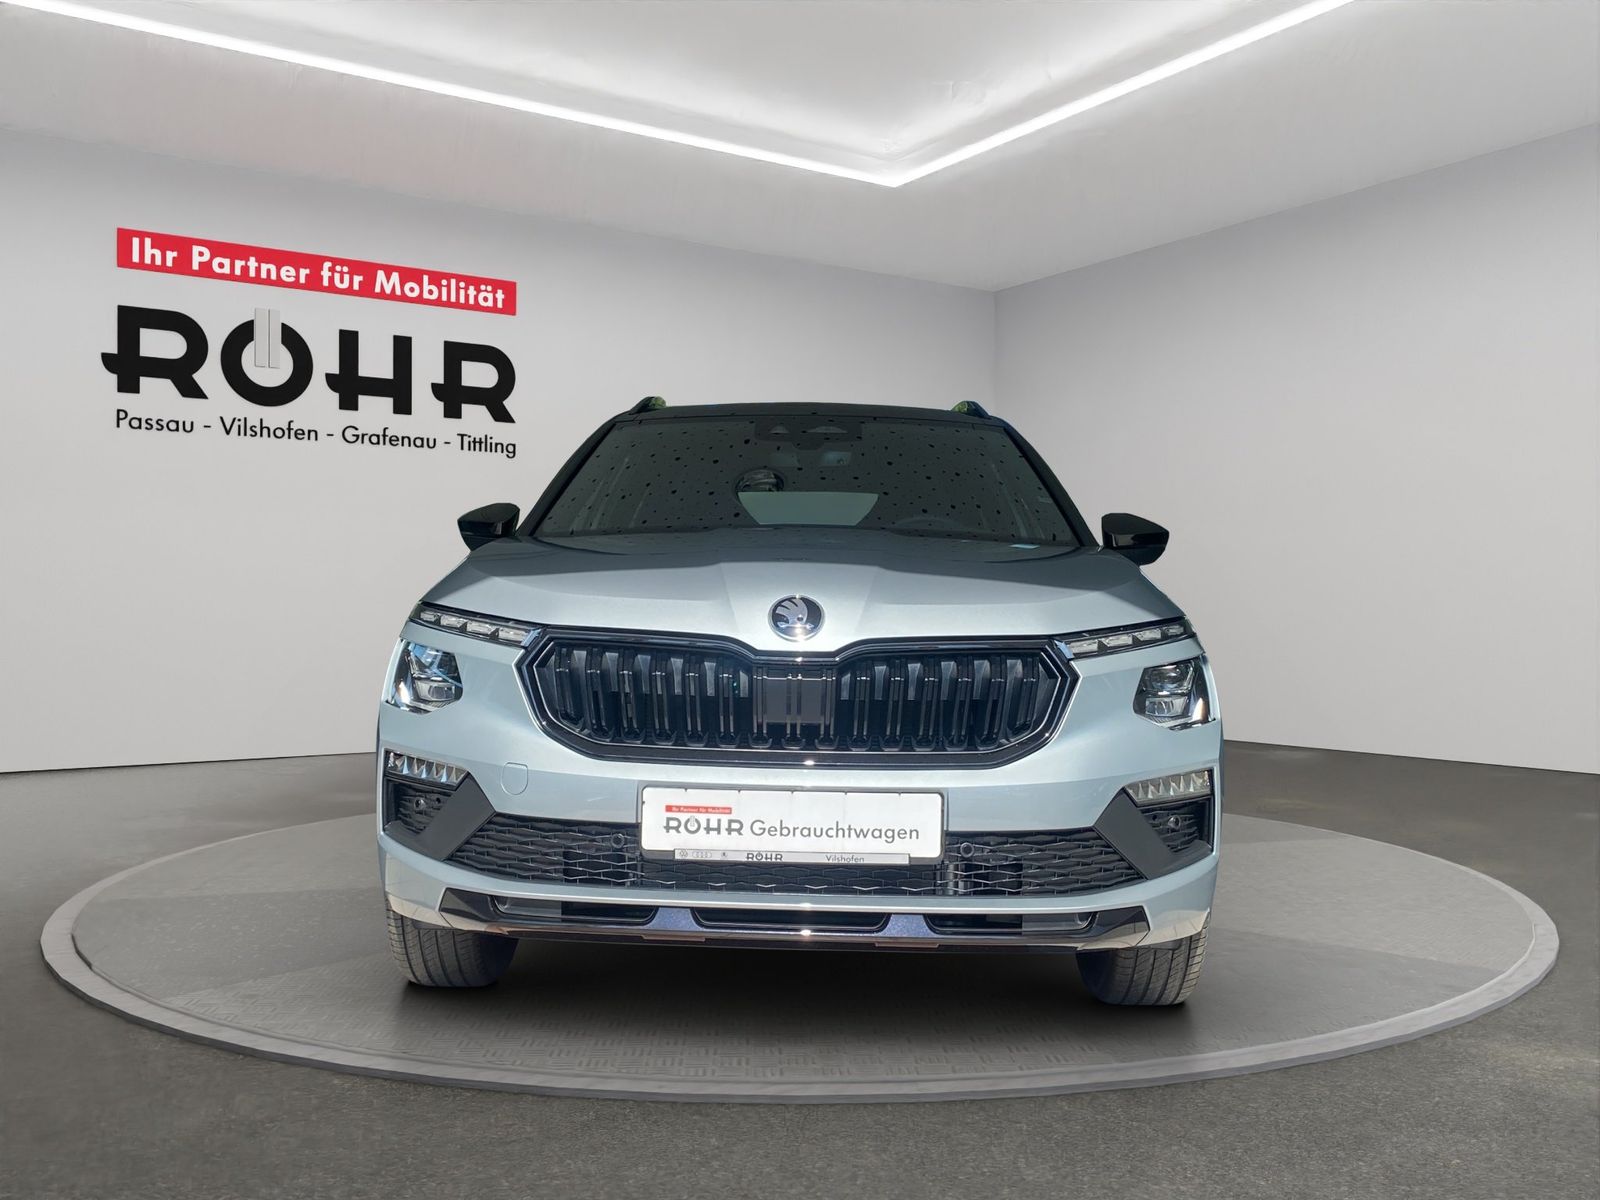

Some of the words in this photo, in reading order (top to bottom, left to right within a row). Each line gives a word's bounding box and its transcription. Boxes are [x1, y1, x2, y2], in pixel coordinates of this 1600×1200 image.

[131, 236, 178, 268] Ihr
[191, 244, 311, 285] Partner
[320, 261, 364, 291] für
[374, 269, 506, 309] Mobilität
[116, 408, 195, 434] Passau
[219, 415, 319, 442] Vilshofen
[341, 425, 437, 450] Grafenau
[456, 432, 517, 459] Tittling
[749, 819, 920, 844] Gebrauchtwagen
[825, 854, 865, 864] Vilshofen
